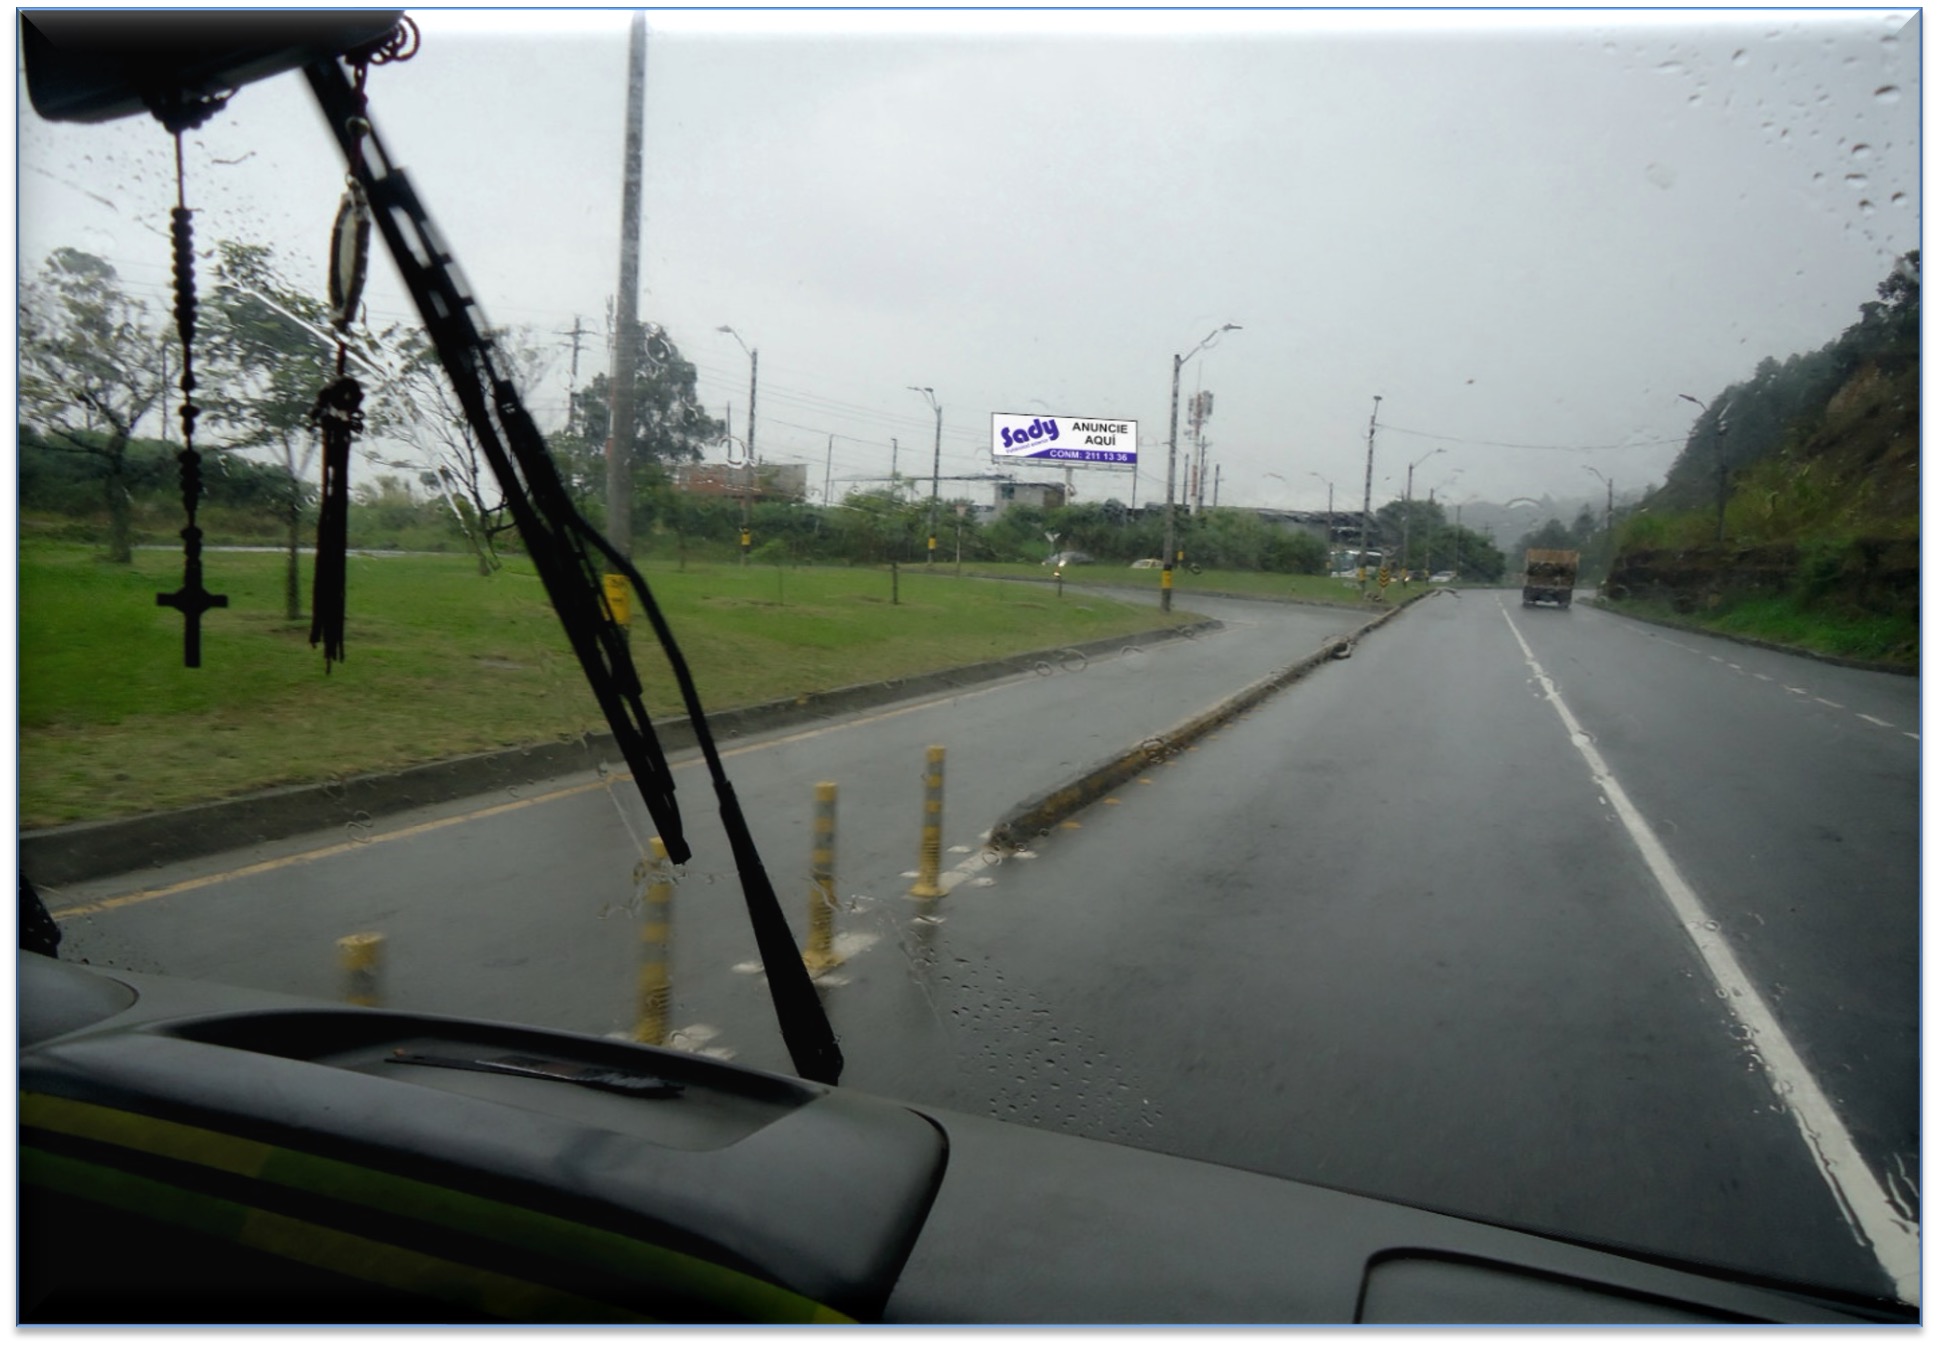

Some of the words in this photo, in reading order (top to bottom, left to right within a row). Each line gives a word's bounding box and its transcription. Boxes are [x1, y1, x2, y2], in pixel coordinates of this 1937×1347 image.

[1001, 419, 1059, 448] Sady
[1072, 422, 1128, 434] ANUNCIE
[1085, 434, 1116, 446] AQUÍ
[1050, 451, 1083, 459] CONM:
[1085, 452, 1100, 460] 211
[1104, 453, 1114, 461] 13
[1117, 453, 1128, 461] 36
